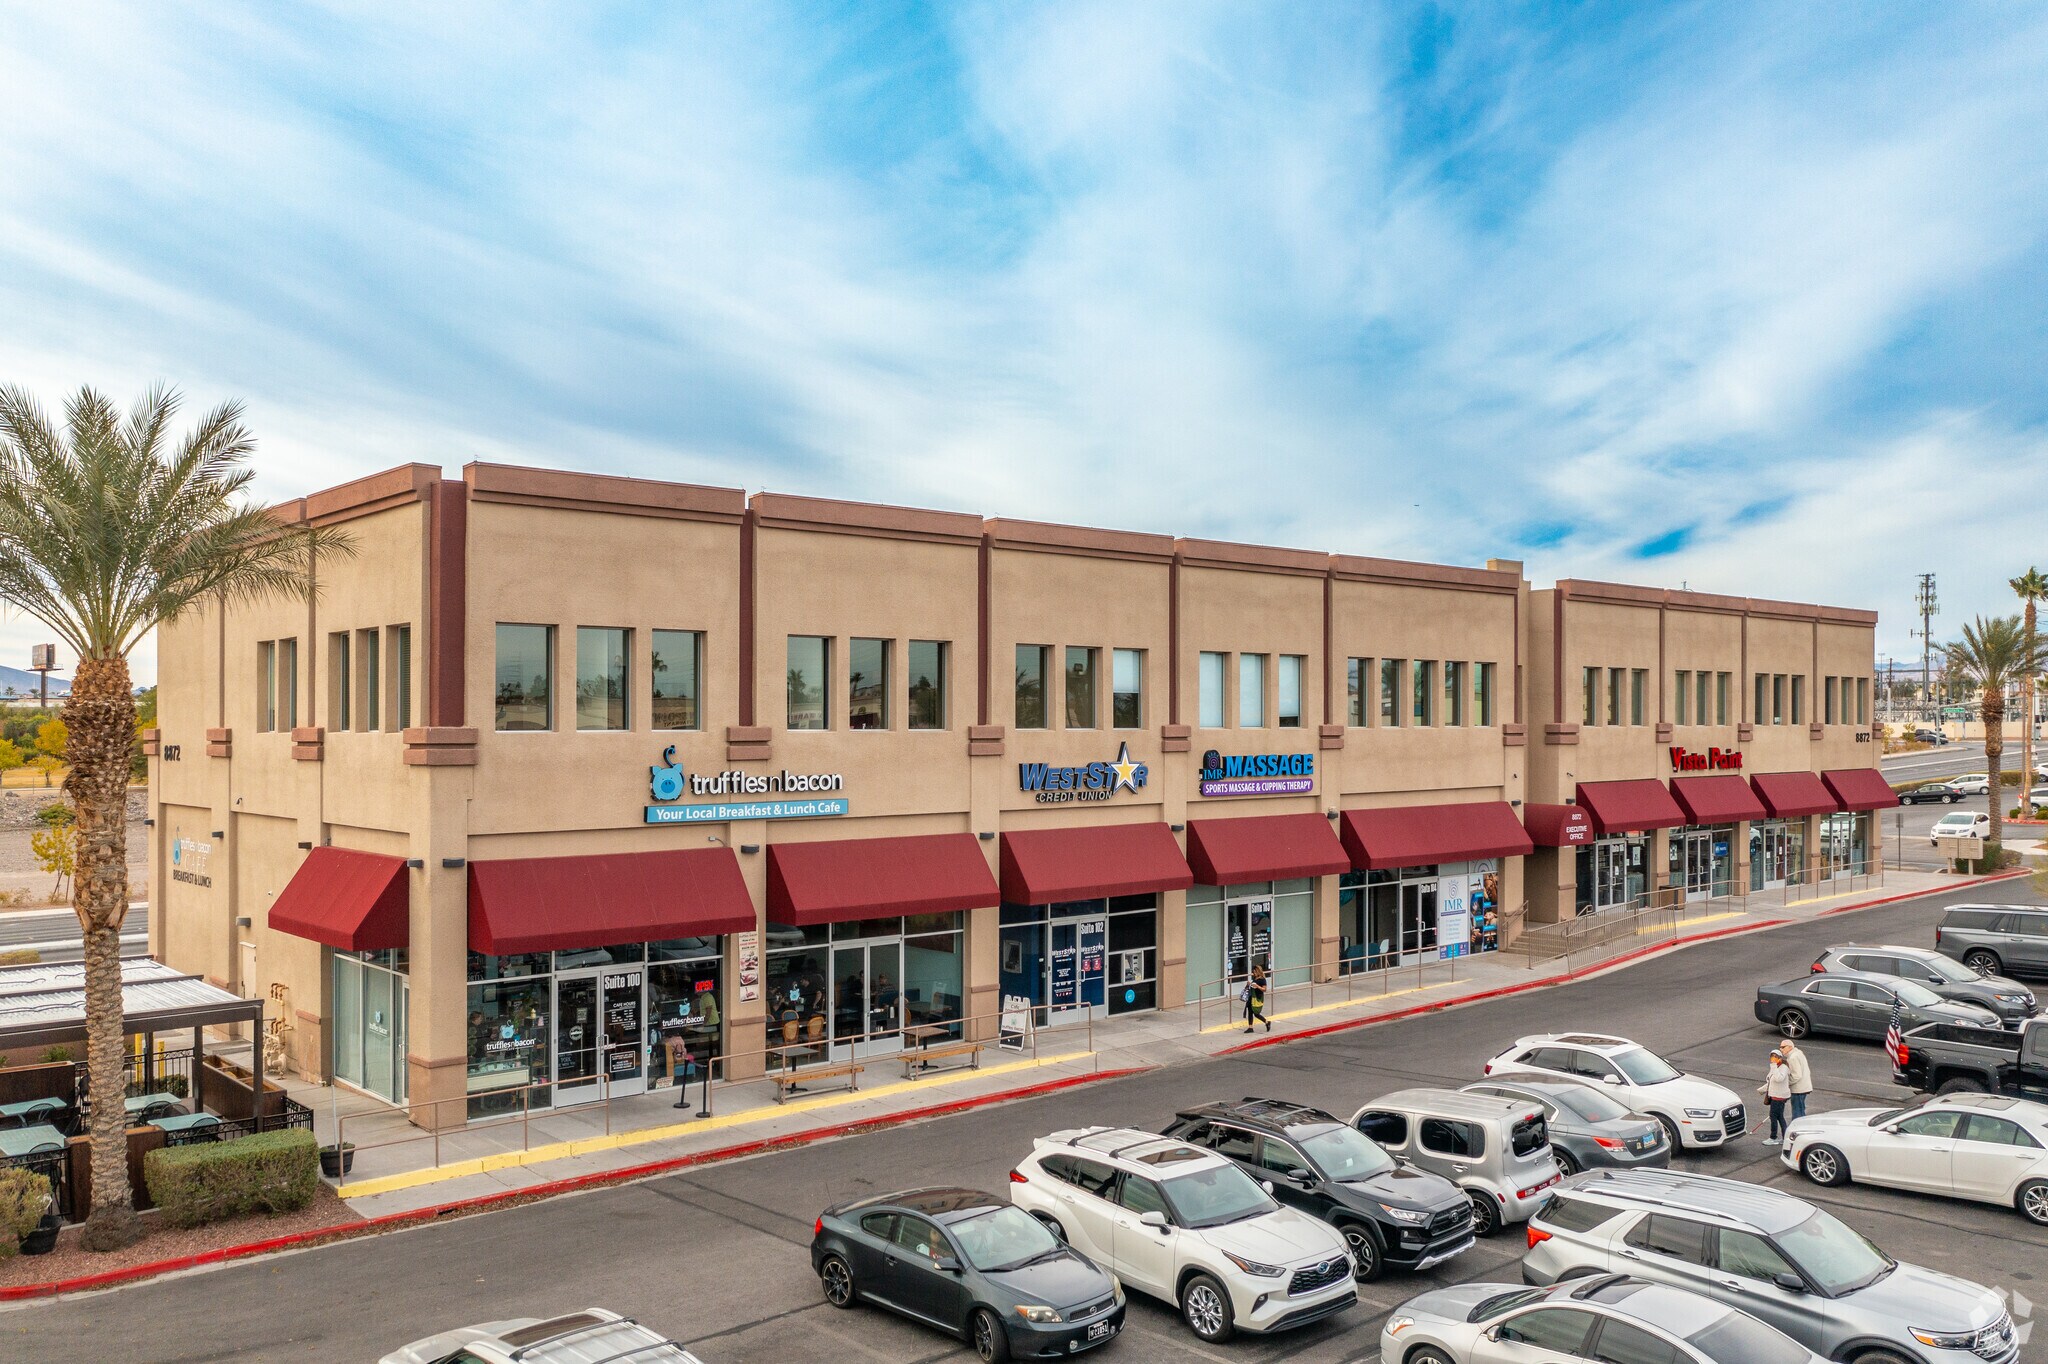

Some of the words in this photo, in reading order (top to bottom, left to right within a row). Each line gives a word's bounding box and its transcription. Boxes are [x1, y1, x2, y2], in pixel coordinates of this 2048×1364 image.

[1856, 732, 1870, 743] 8872
[164, 745, 180, 761] 8872
[1669, 746, 1708, 772] Vista
[1708, 747, 1743, 770] Paint
[1223, 753, 1314, 778] MASSAGE
[1203, 769, 1223, 780] IMR
[1205, 783, 1228, 793] SPORTS
[1229, 782, 1255, 793] MASSAGE
[1256, 782, 1261, 791] &
[1261, 781, 1286, 791] CUPPING
[1287, 780, 1311, 790] THERAPY
[1036, 792, 1076, 803] CREDIT
[1078, 790, 1113, 801] UNION
[656, 809, 683, 821] Your
[686, 806, 716, 819] Local
[720, 804, 771, 818] Breakfast
[773, 804, 782, 815] &
[784, 802, 815, 815] Lunch
[817, 801, 840, 813] Cafe
[1566, 825, 1587, 833] EXECUTIVE
[173, 869, 194, 884] BREAKFAST
[198, 874, 212, 888] LUNCH
[1251, 903, 1262, 913] Suite
[1444, 898, 1463, 911] IMR
[1080, 922, 1094, 934] Suite
[1095, 921, 1104, 932] 102
[604, 975, 625, 989] Suite
[627, 973, 640, 987] 100
[695, 980, 713, 992] OPEN
